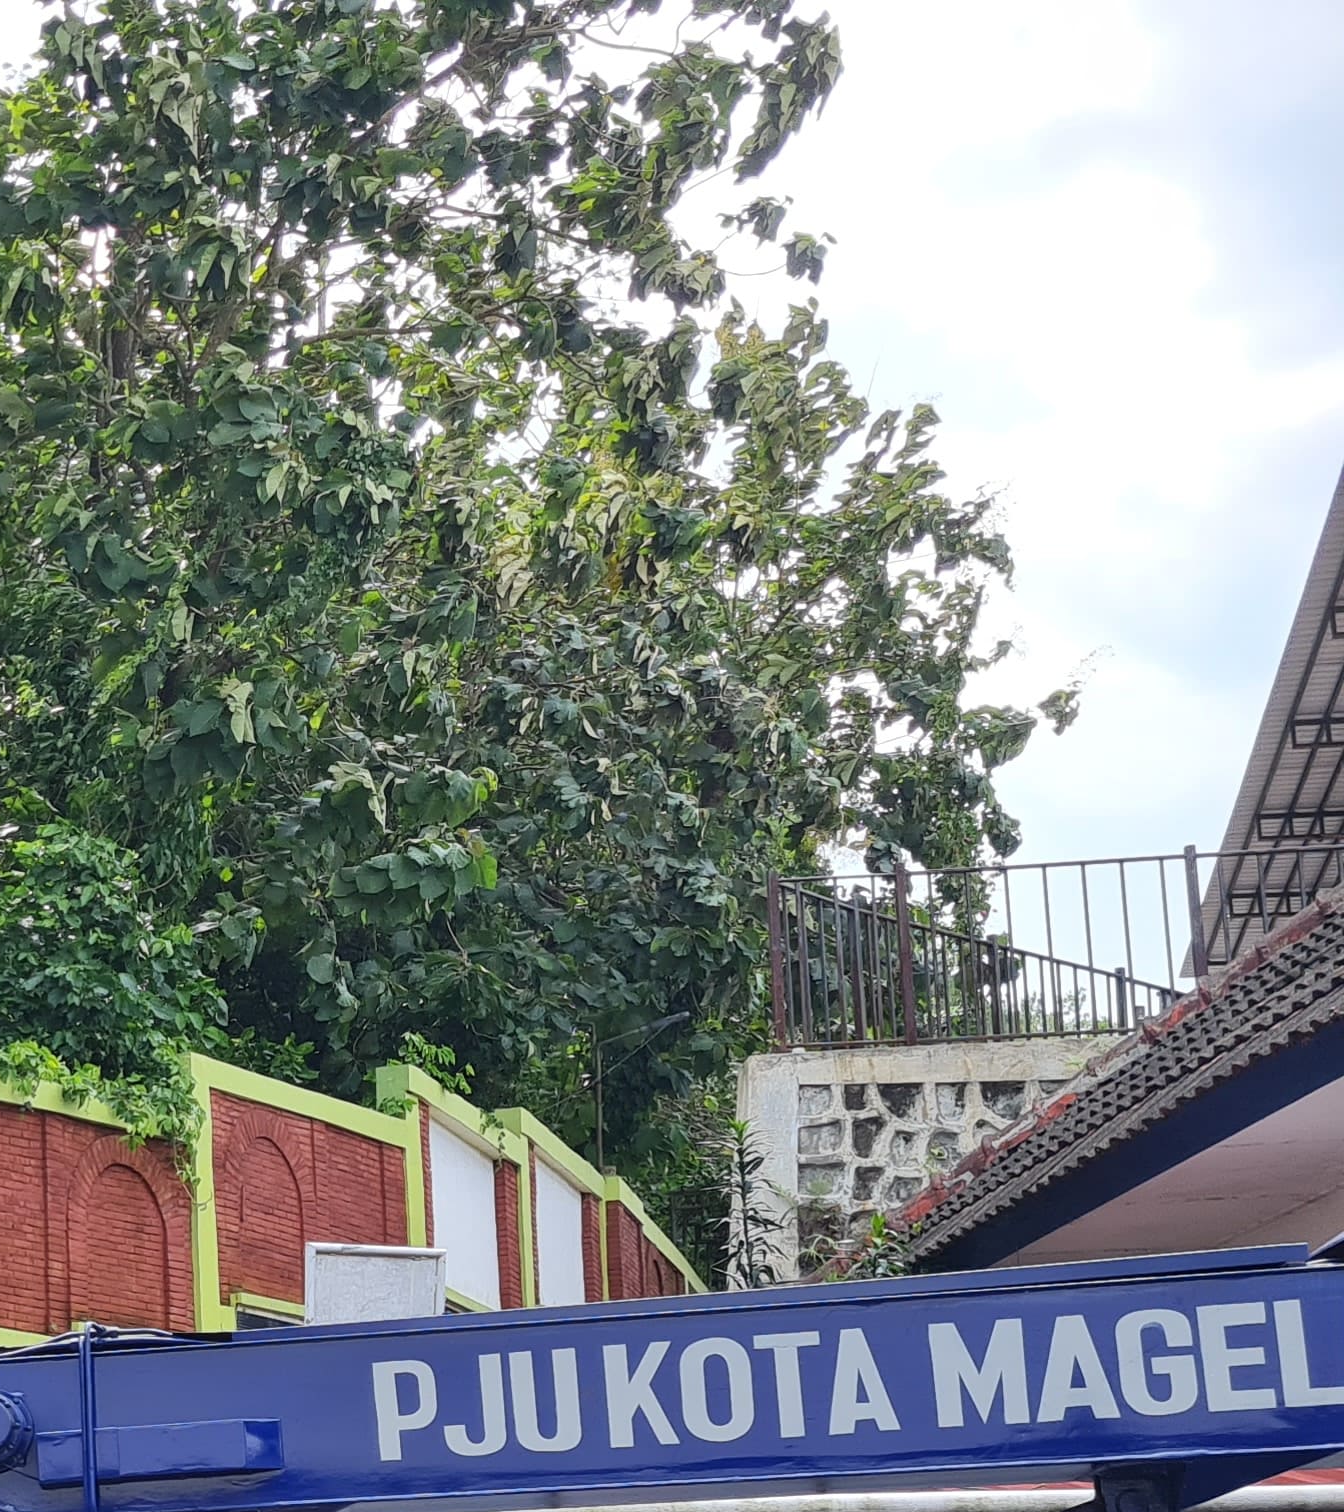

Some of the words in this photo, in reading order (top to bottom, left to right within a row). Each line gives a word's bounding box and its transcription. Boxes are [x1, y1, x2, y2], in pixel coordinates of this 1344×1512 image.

[371, 1346, 583, 1462] PJU
[601, 1327, 902, 1450] KOTA
[927, 1298, 1344, 1428] MAGEL
